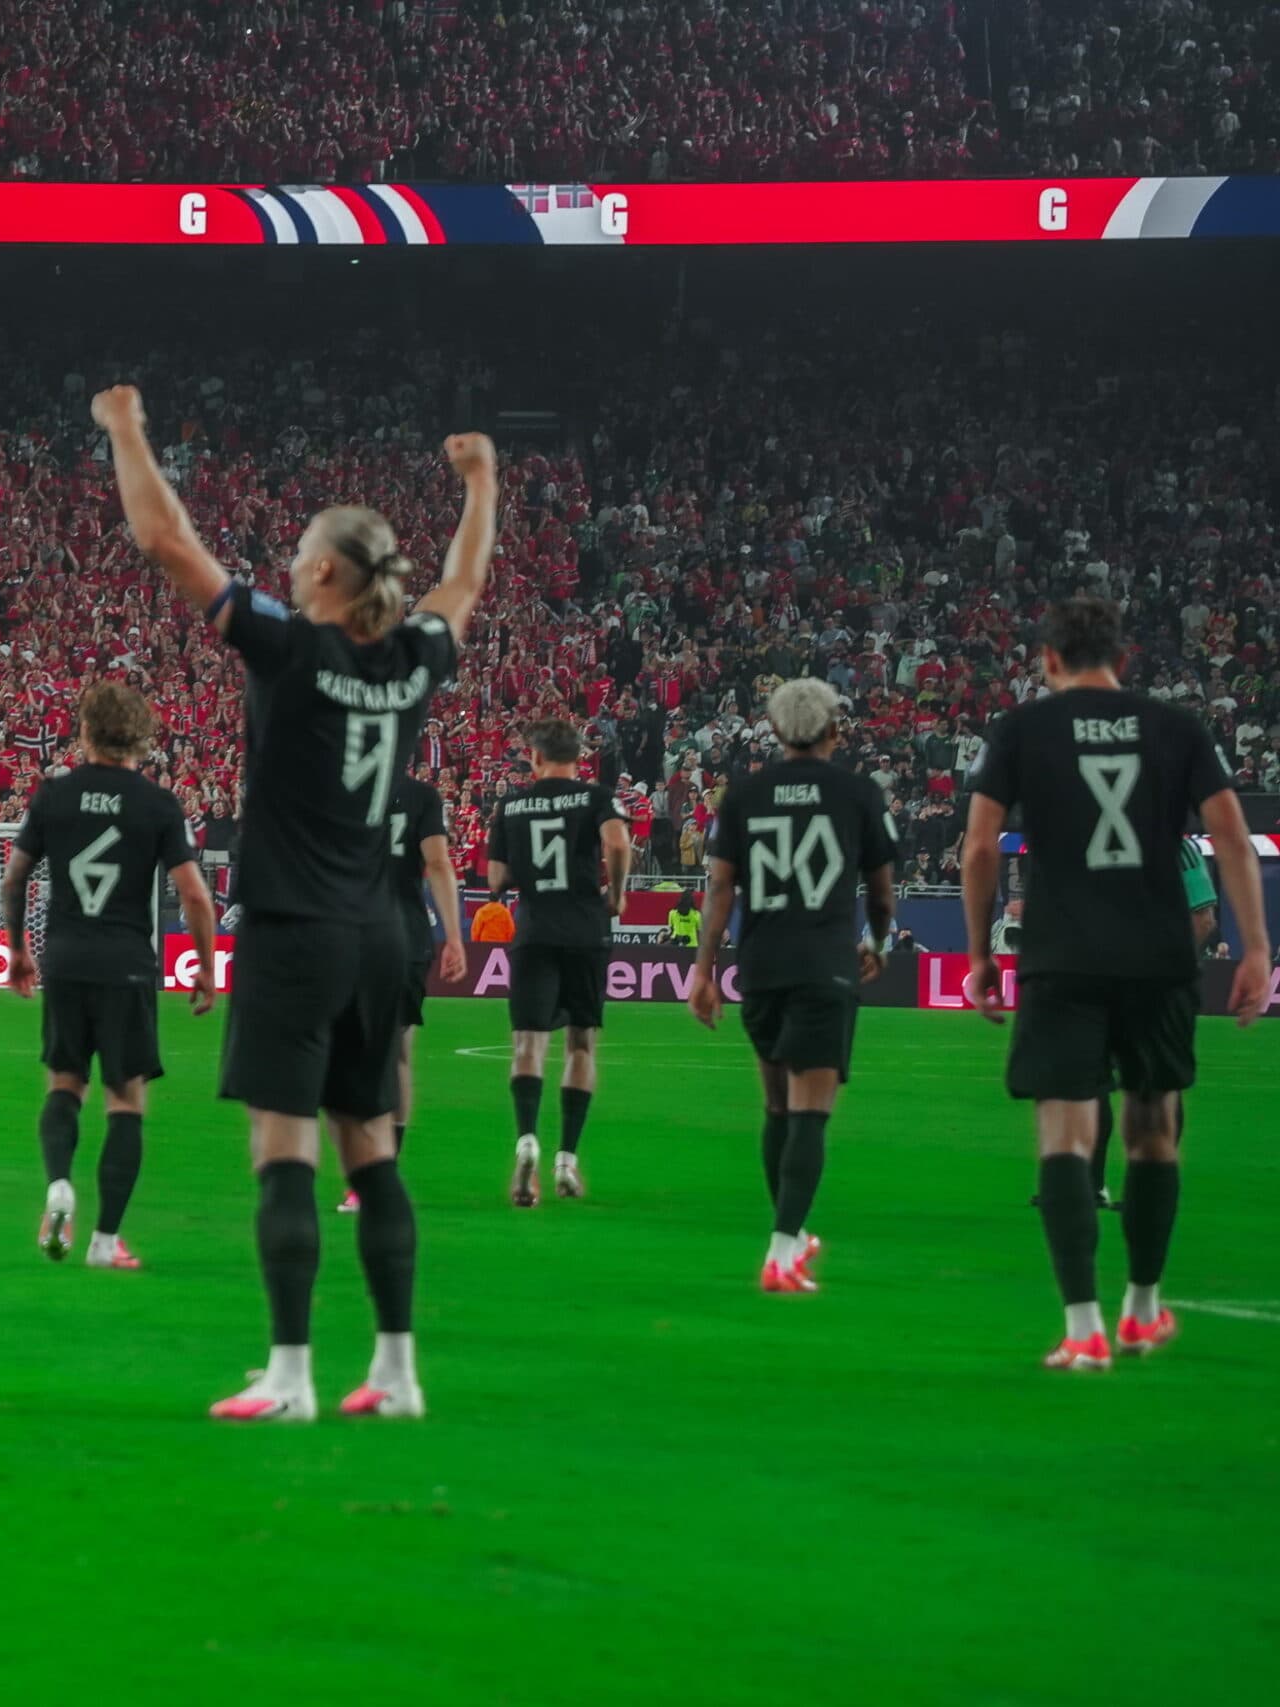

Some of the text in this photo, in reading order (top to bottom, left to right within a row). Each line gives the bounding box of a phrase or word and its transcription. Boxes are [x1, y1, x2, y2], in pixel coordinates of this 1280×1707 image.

[179, 192, 207, 235] G
[601, 193, 629, 236] G
[1039, 187, 1068, 231] G
[1073, 716, 1140, 743] BERGE
[342, 711, 399, 827] 9
[80, 791, 122, 815] BERG
[774, 784, 821, 806] NUSA
[1078, 753, 1143, 870] 8
[69, 825, 121, 917] 6
[529, 817, 569, 892] 5
[747, 815, 845, 912] 20
